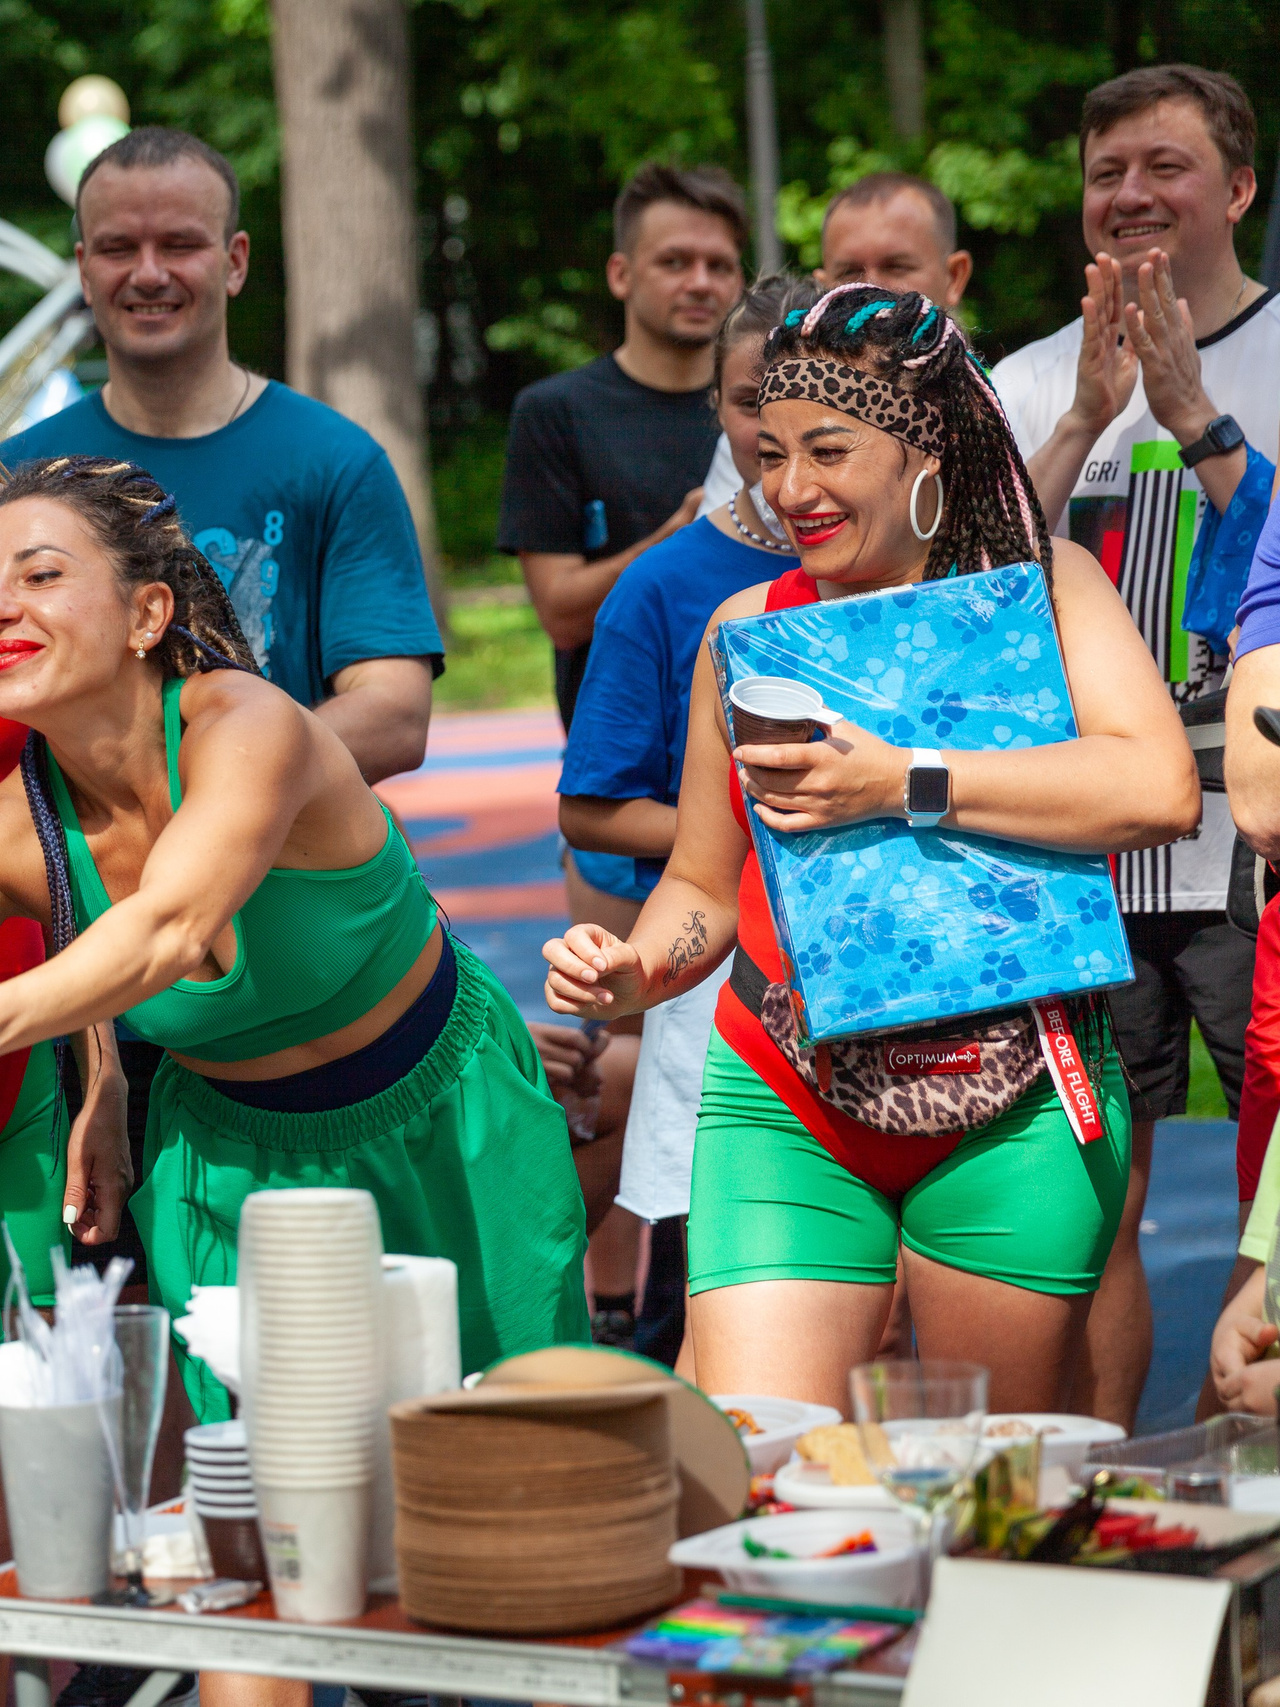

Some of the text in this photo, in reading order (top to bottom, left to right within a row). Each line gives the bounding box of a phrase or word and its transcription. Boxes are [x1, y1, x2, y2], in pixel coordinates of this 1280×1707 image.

[1085, 460, 1120, 482] GRi
[895, 1052, 958, 1067] OPTIMUM
[1046, 1009, 1076, 1069] BEFORE
[1066, 1071, 1096, 1125] FLIGHT
